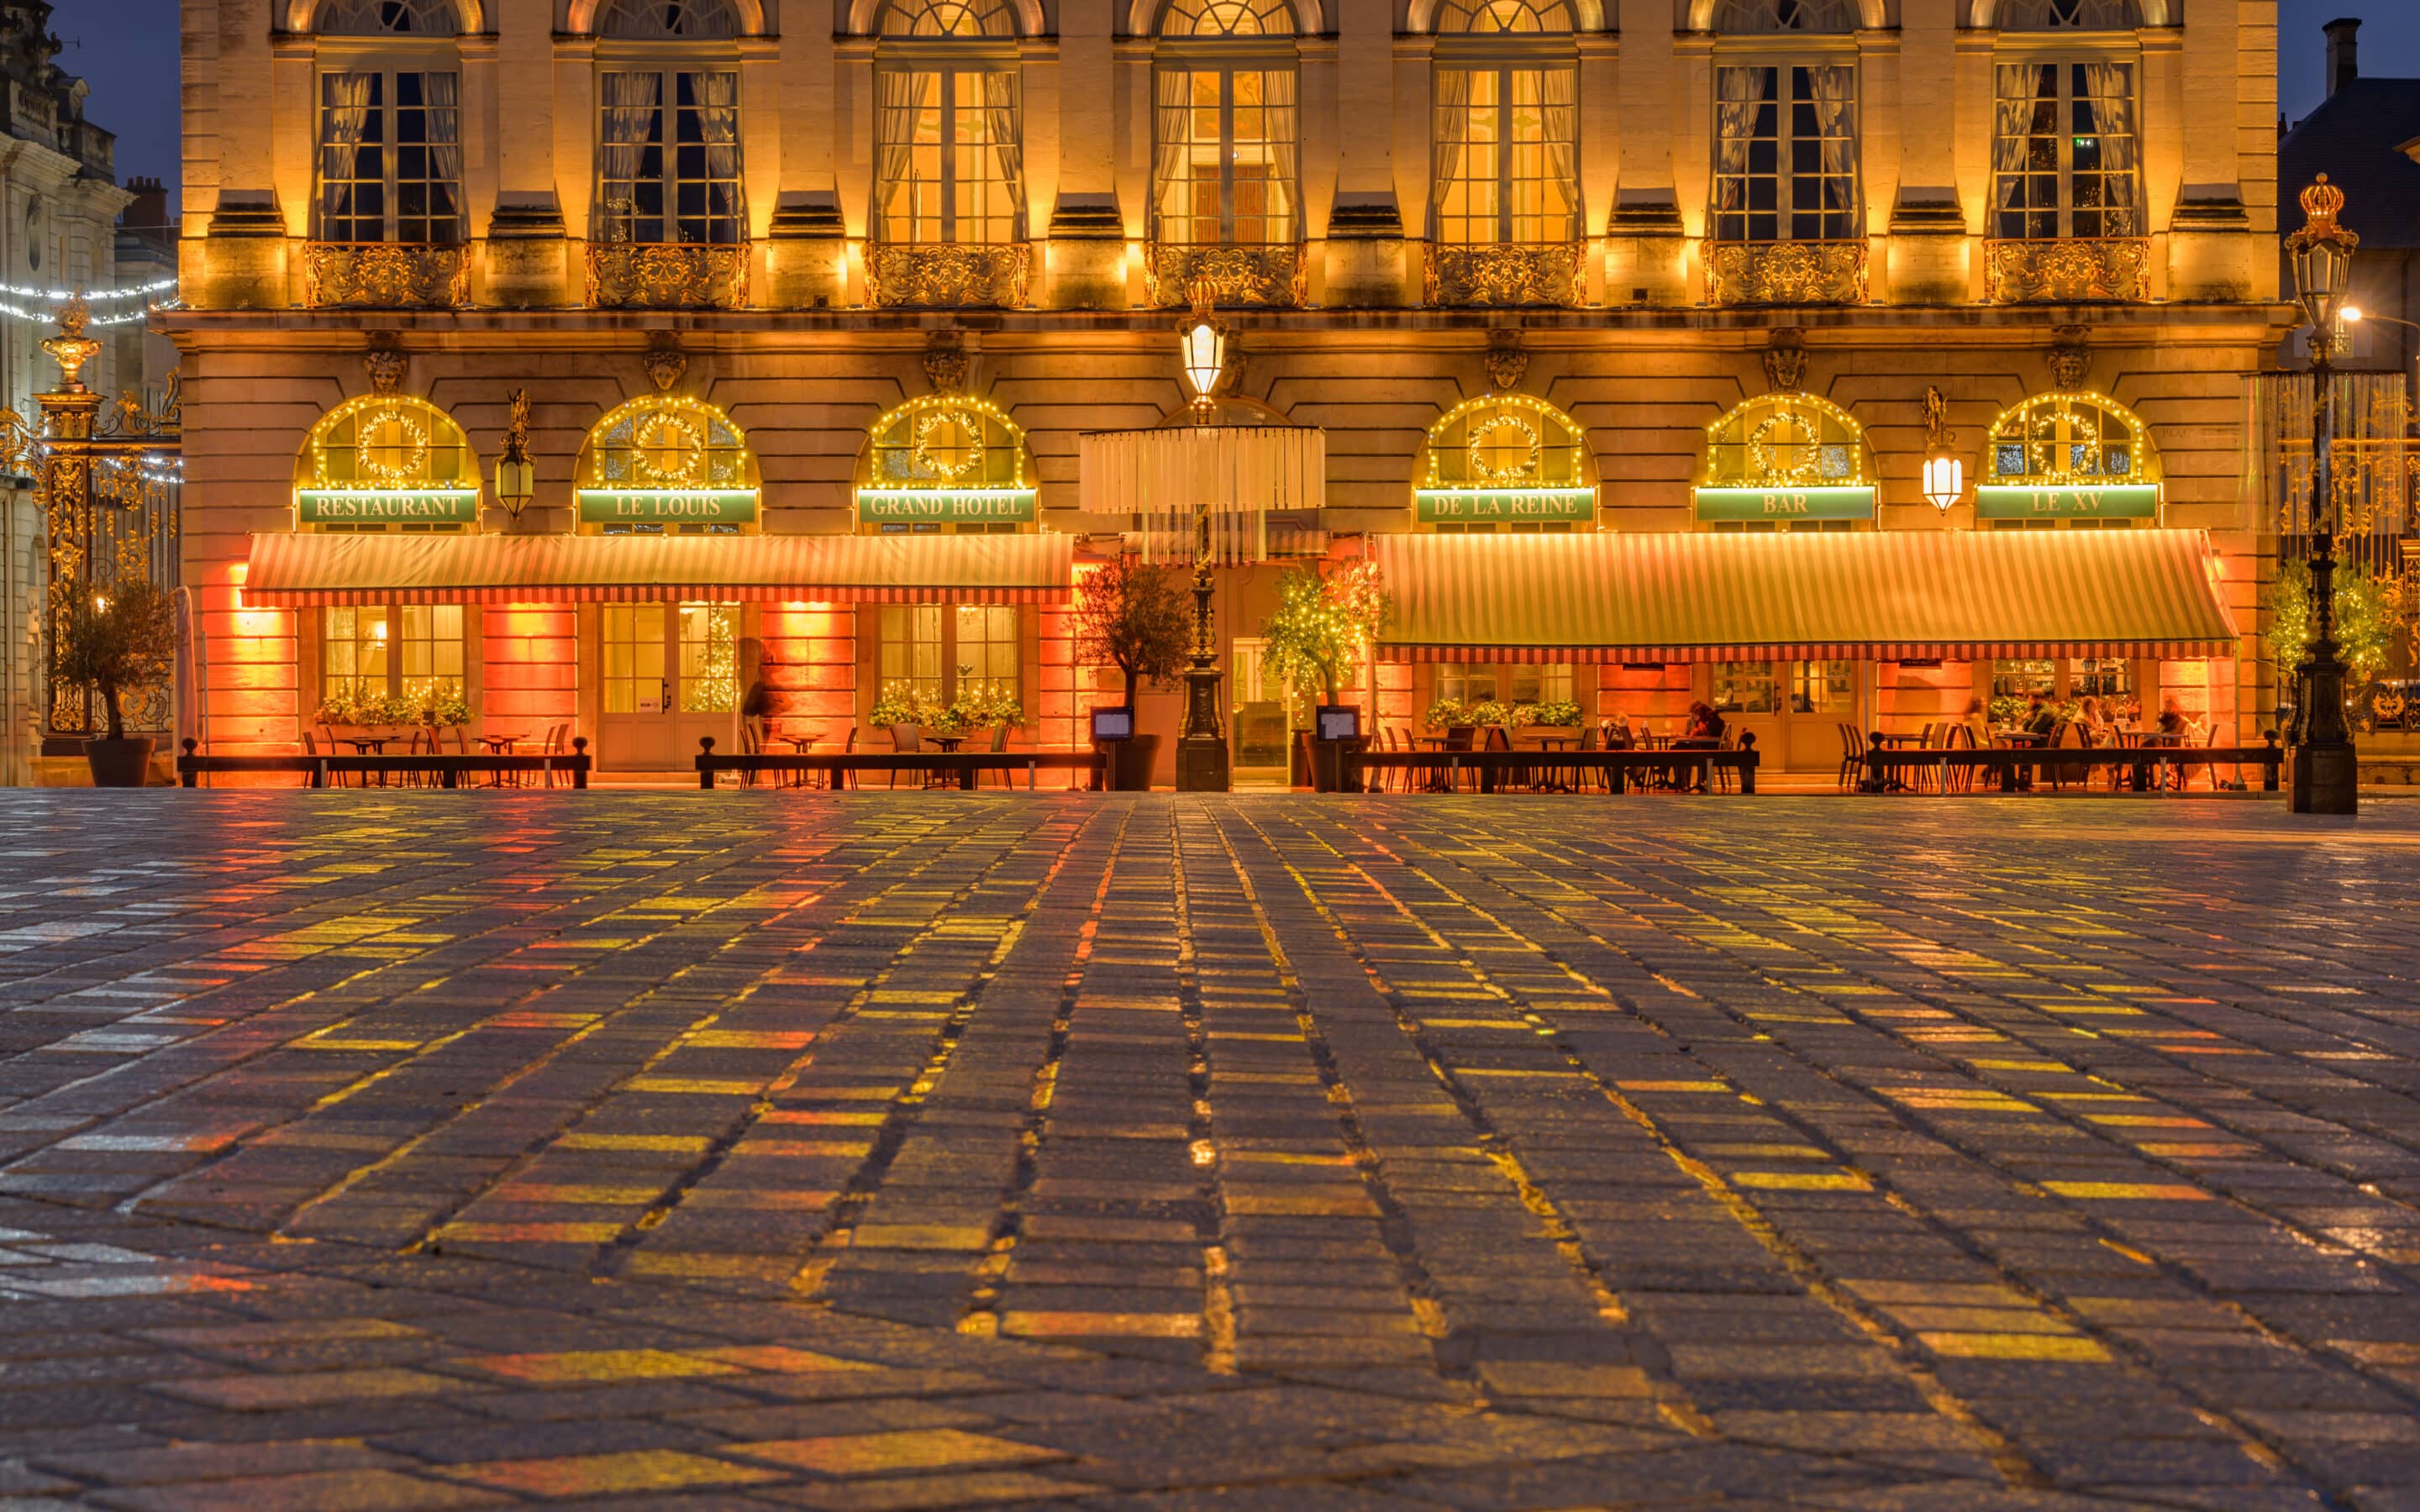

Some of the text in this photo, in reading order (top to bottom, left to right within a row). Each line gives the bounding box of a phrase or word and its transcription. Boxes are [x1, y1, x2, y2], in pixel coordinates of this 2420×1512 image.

[315, 496, 460, 516] RESTAURANT
[616, 496, 721, 516] LE LOUIS
[871, 496, 1022, 515] GRAND HOTEL
[1434, 494, 1578, 515] DE LA REINE
[1762, 494, 1808, 513] BAR
[2032, 491, 2104, 512] LE XV
